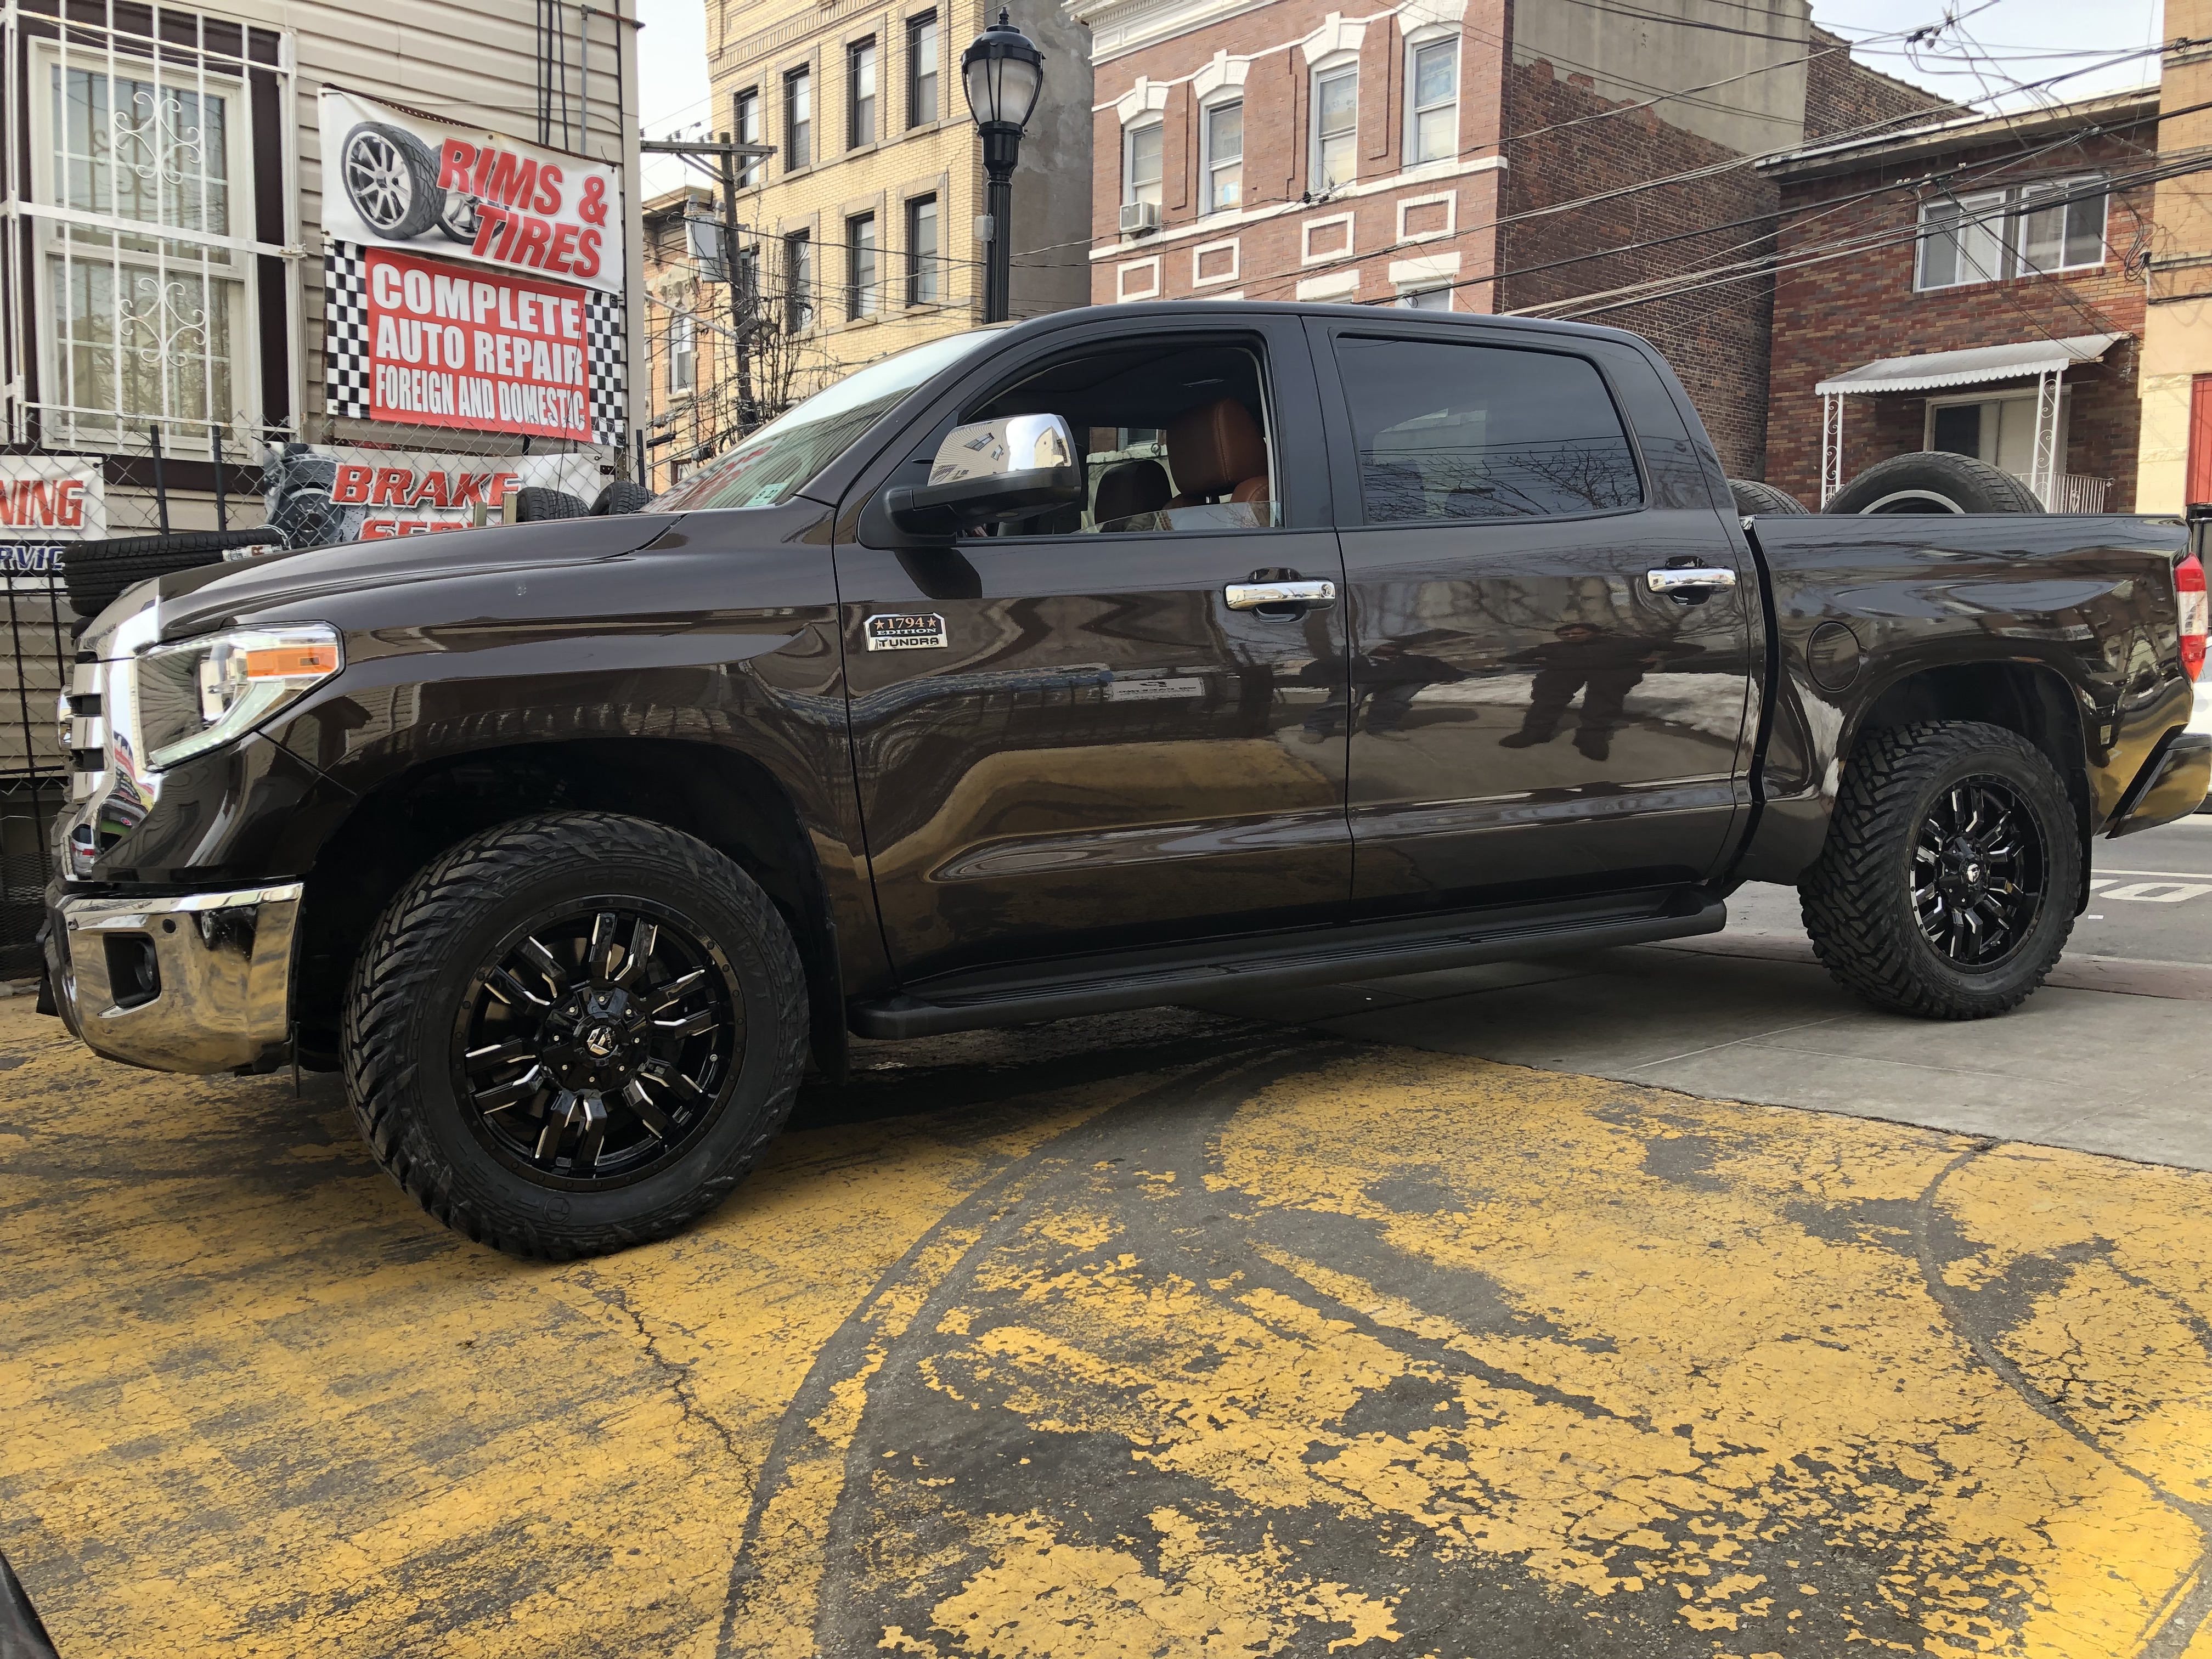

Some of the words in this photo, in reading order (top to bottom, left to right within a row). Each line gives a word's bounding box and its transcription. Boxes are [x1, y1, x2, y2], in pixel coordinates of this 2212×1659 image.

[436, 137, 563, 216] RIMS
[578, 176, 608, 228] &
[471, 203, 602, 279] TIRES
[372, 263, 582, 339] COMPLETE
[376, 314, 465, 369] AUTO
[474, 330, 583, 386] REPAIR
[376, 364, 454, 415] FOREIGN
[458, 376, 495, 419] AND
[498, 381, 585, 431] DOMESTIC
[330, 464, 521, 509] BRAKE
[877, 628, 936, 636] EDITION
[878, 637, 939, 647] TUNDRA
[887, 617, 924, 629] 1794
[583, 869, 737, 935] GRIPPER
